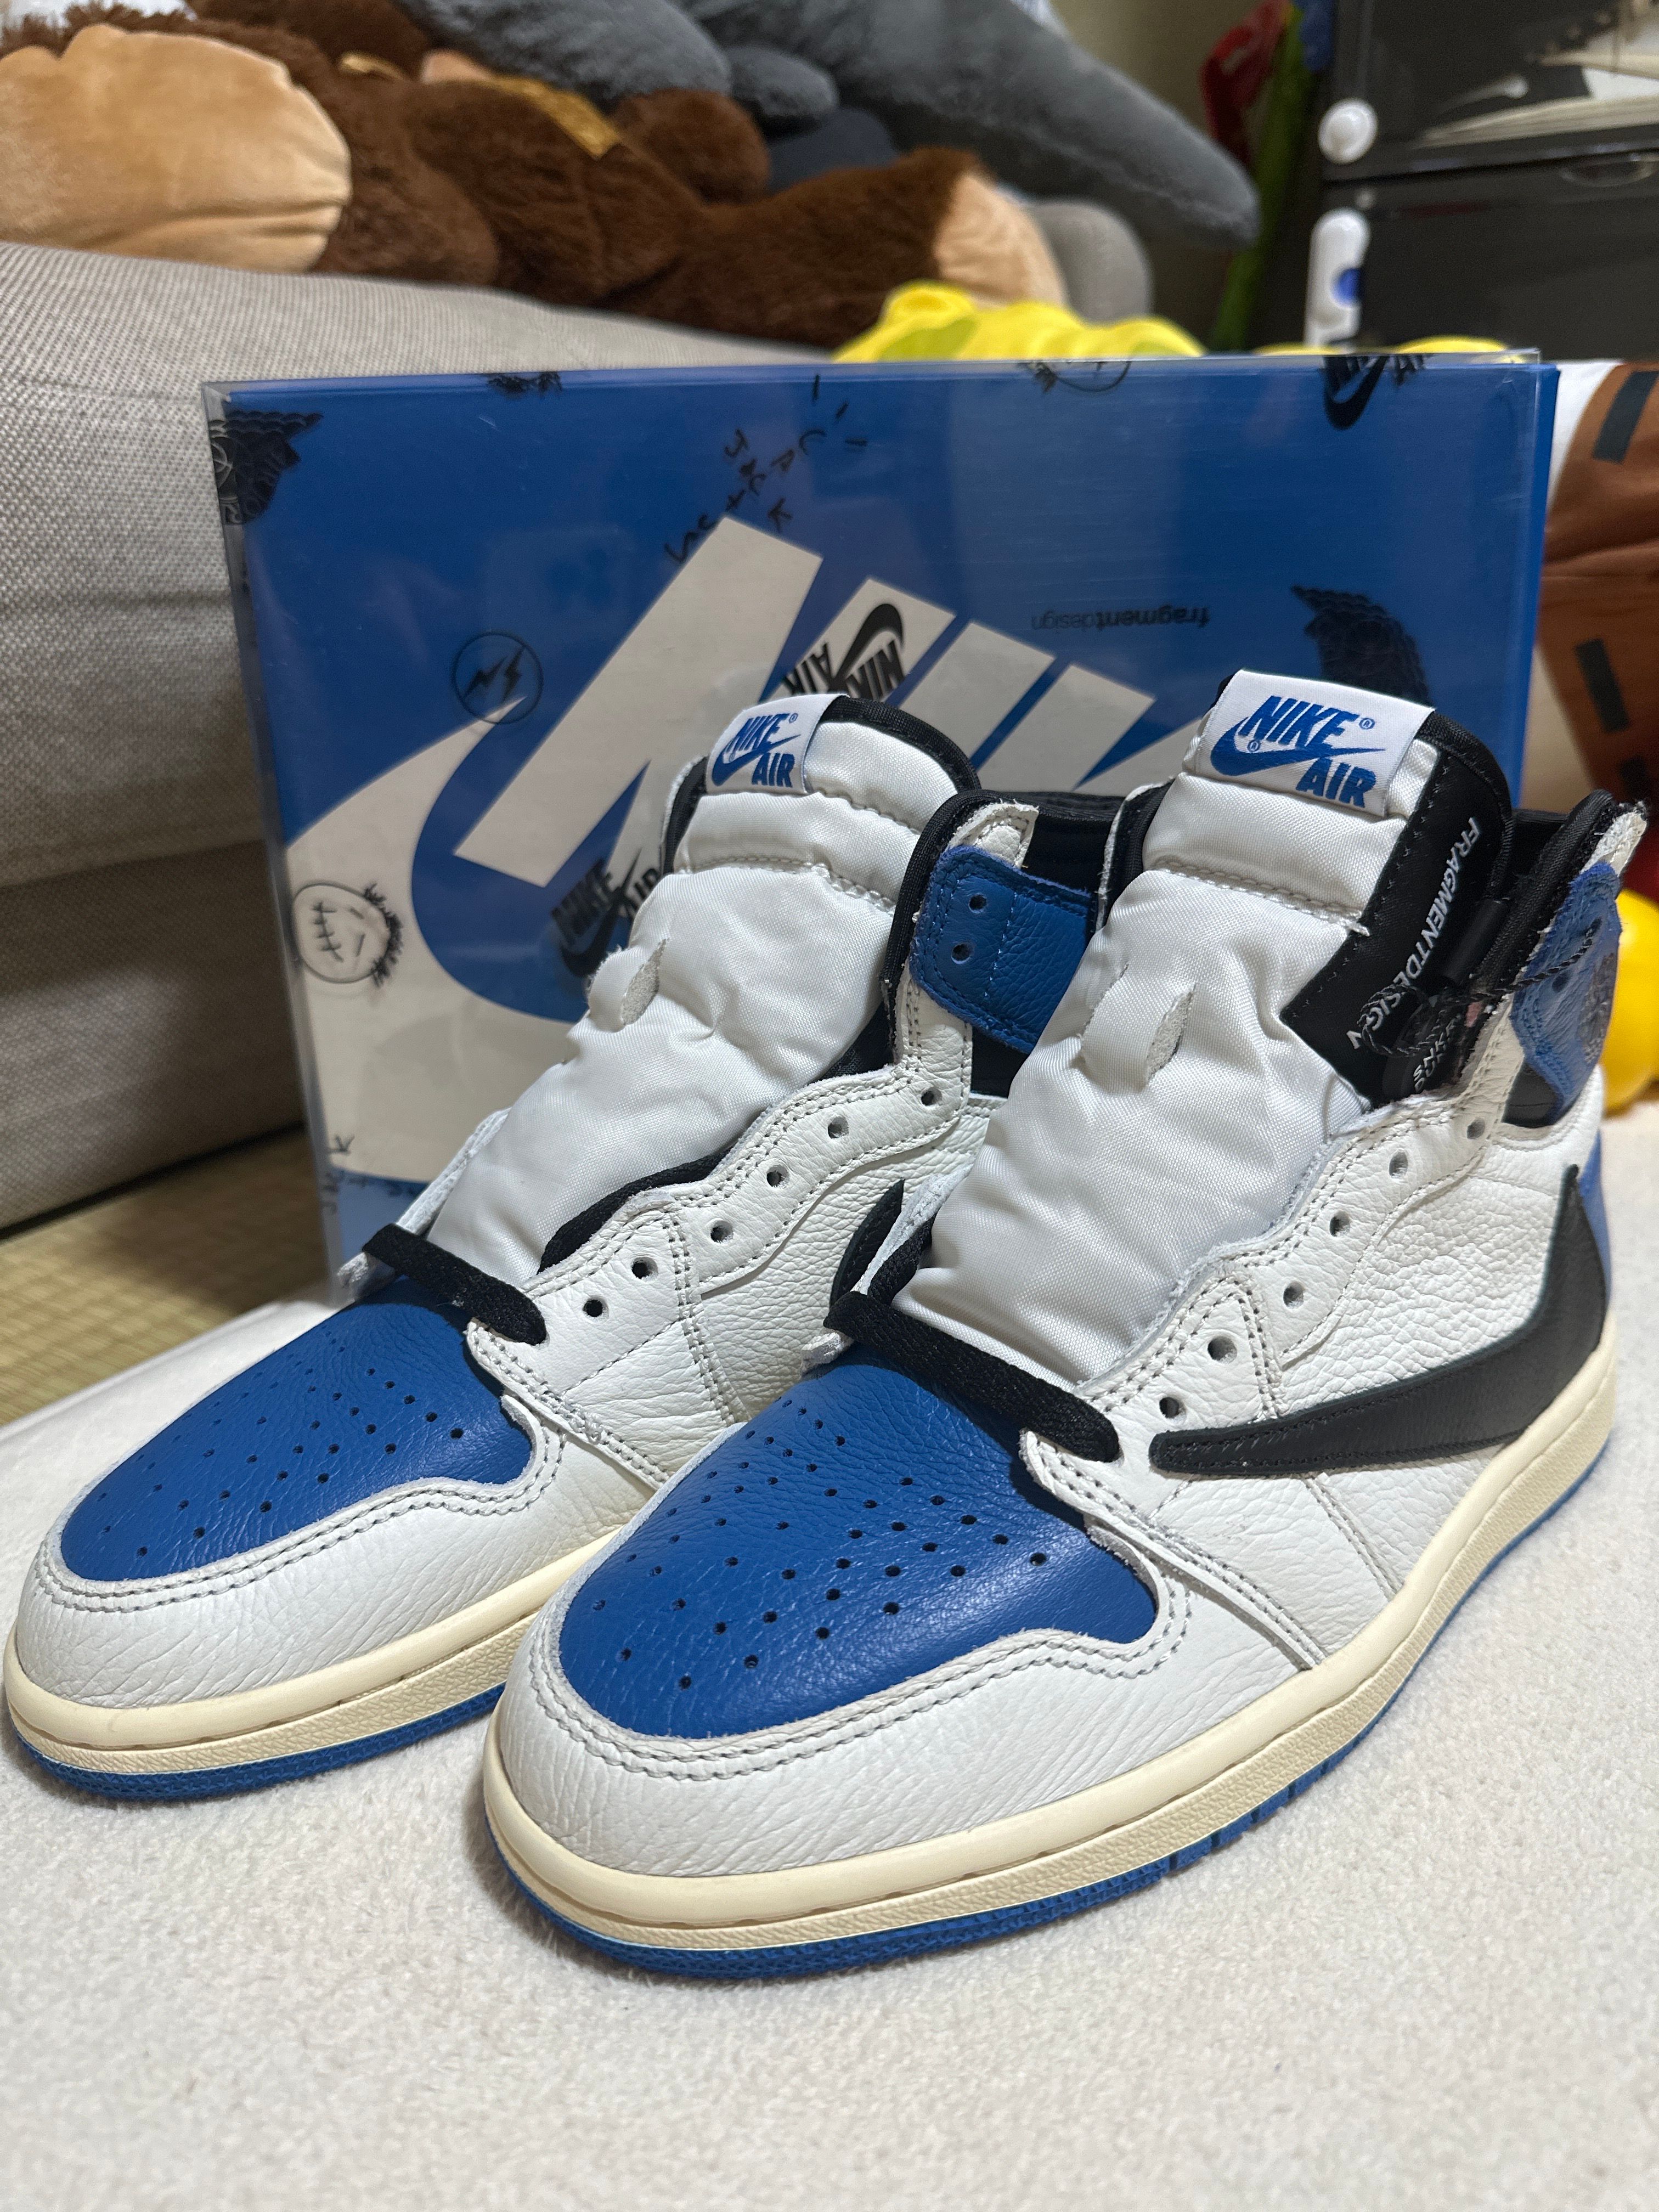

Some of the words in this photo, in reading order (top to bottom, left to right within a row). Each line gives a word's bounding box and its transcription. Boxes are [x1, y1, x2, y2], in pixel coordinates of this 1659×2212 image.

[1031, 605, 1210, 633] fragmentdesign
[846, 640, 905, 702] NIK
[724, 713, 791, 751] NIKE
[1238, 695, 1360, 749] NIKE
[751, 753, 795, 788] AIR
[1295, 757, 1376, 808] AIR
